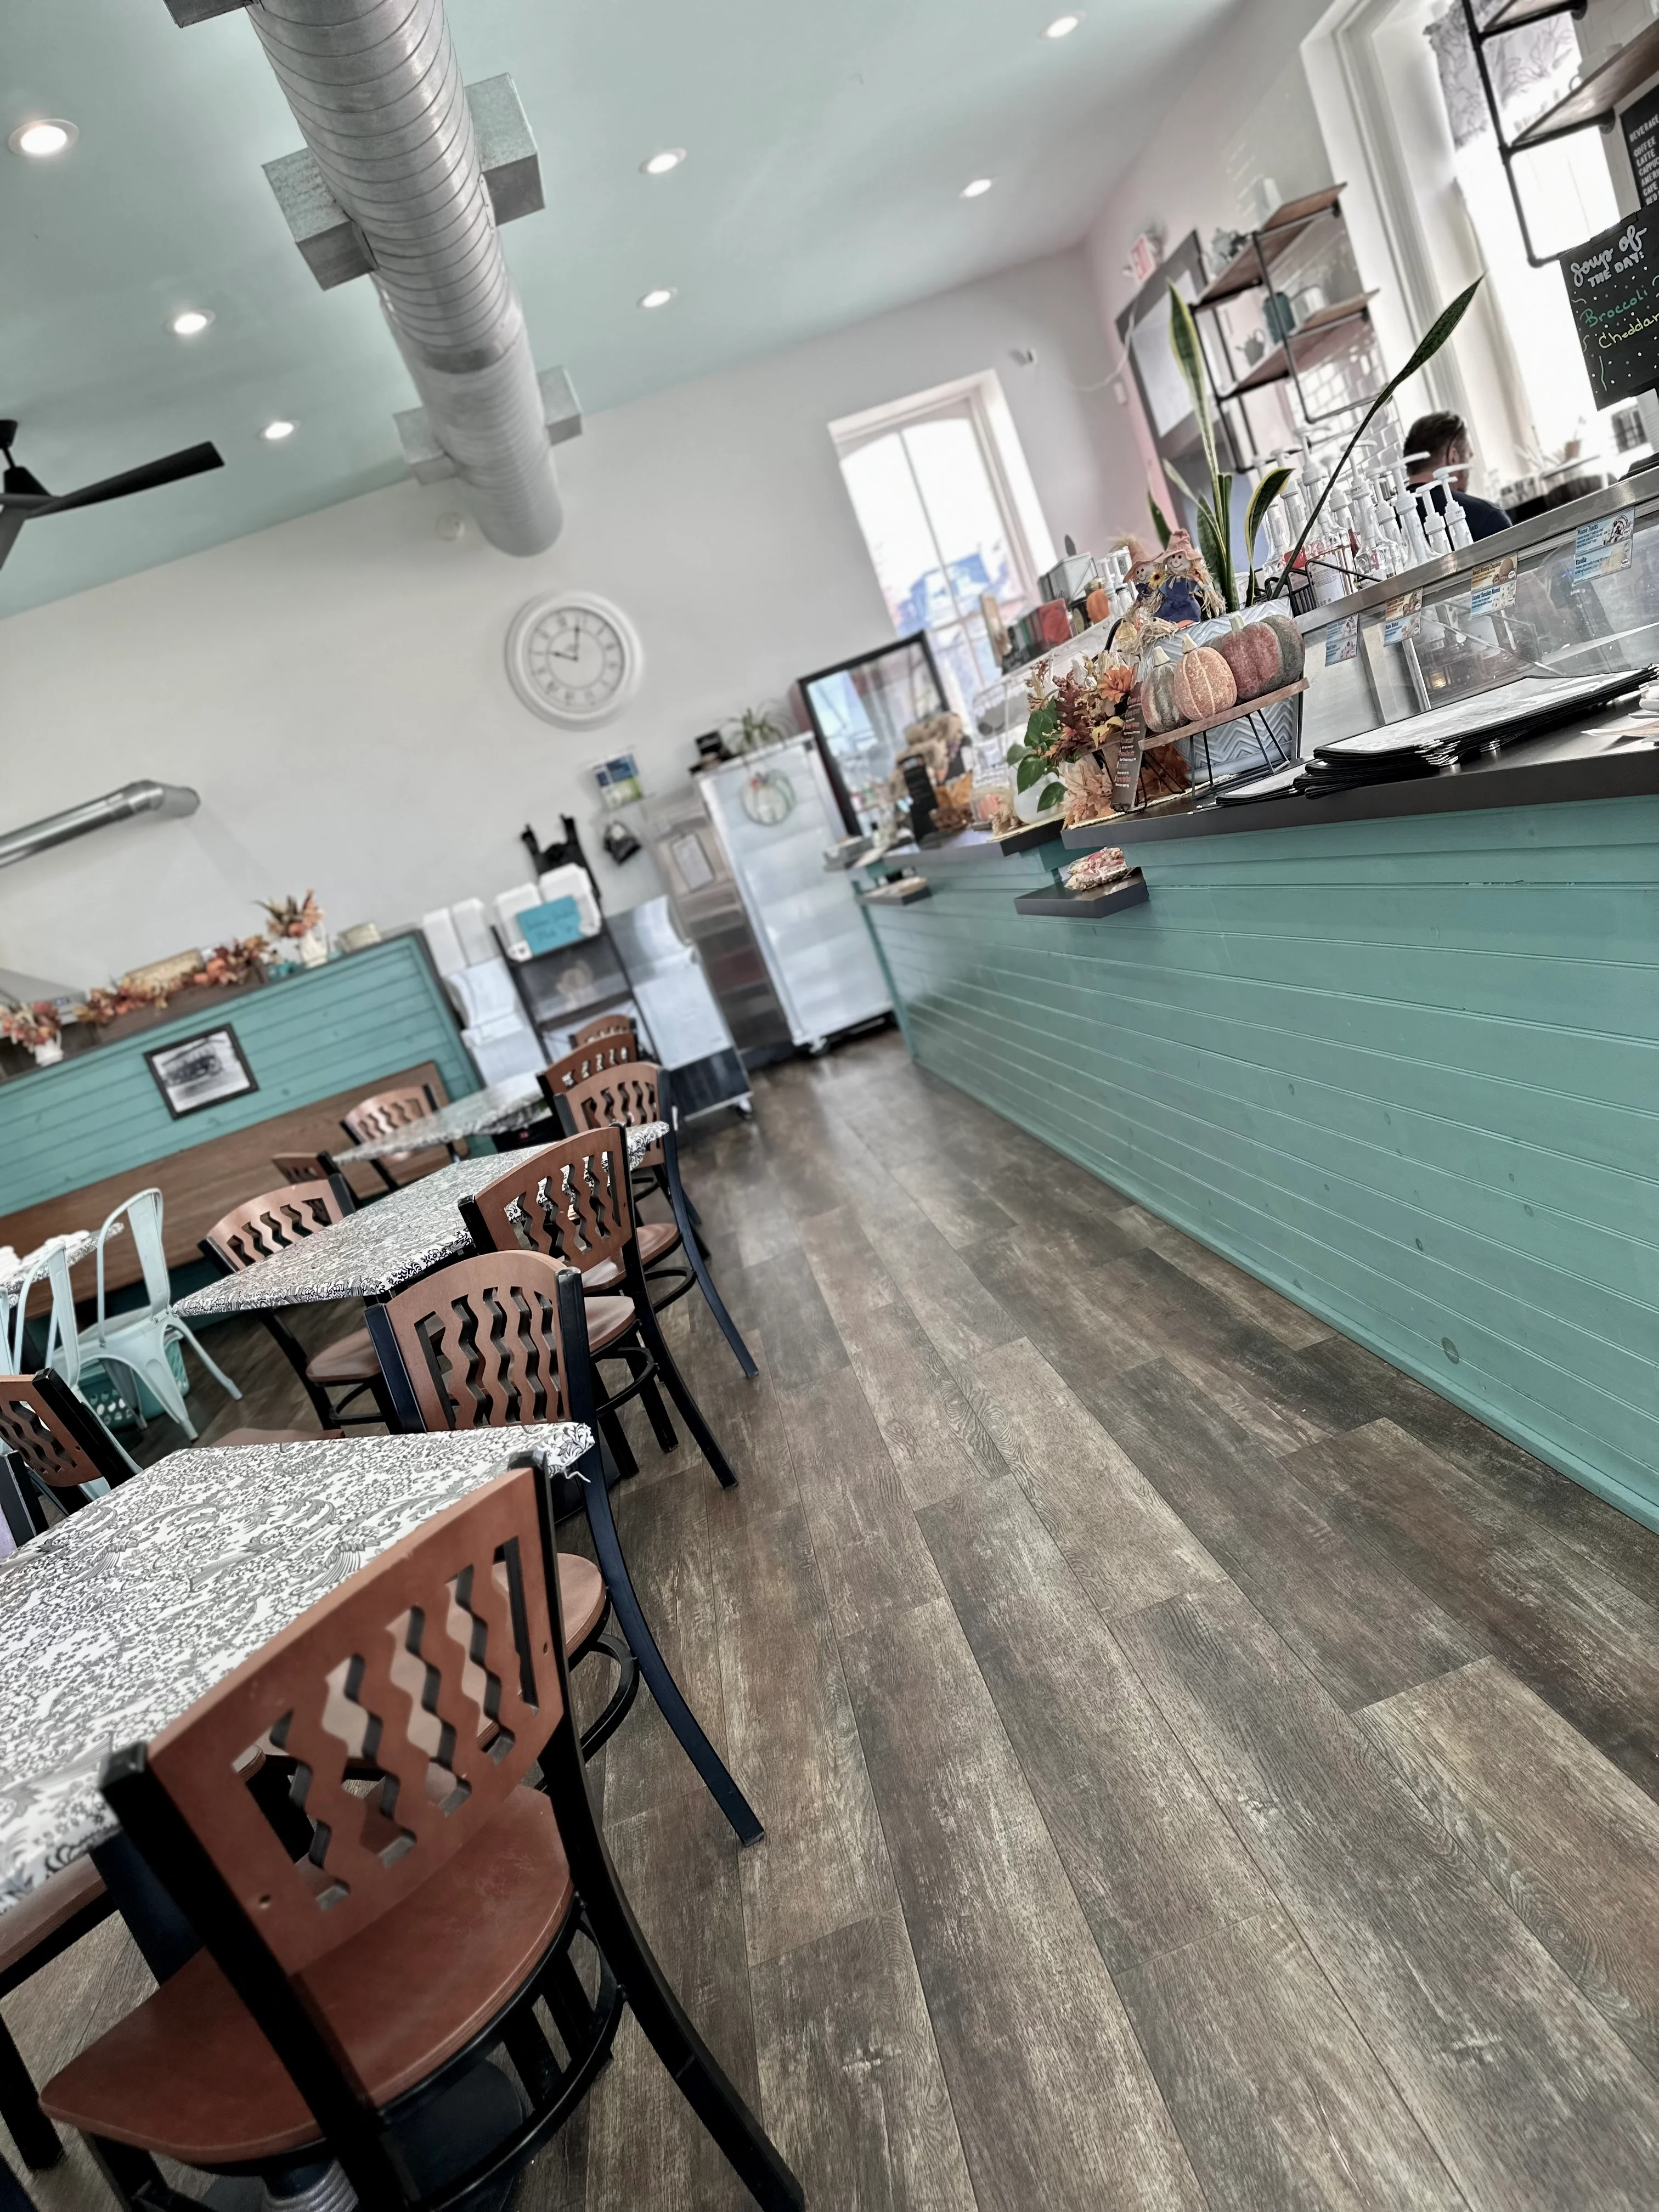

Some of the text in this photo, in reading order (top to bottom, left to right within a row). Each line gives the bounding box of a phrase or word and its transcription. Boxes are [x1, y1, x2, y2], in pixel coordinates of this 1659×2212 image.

[1633, 136, 1656, 157] COFFEE
[1637, 148, 1656, 167] LATTE
[1643, 181, 1658, 196] CAFE
[1646, 193, 1657, 205] RED
[1618, 224, 1647, 252] of
[1588, 251, 1645, 287] THE DAY:
[1579, 289, 1648, 328] Broccoli
[1598, 313, 1659, 348] Cheddar
